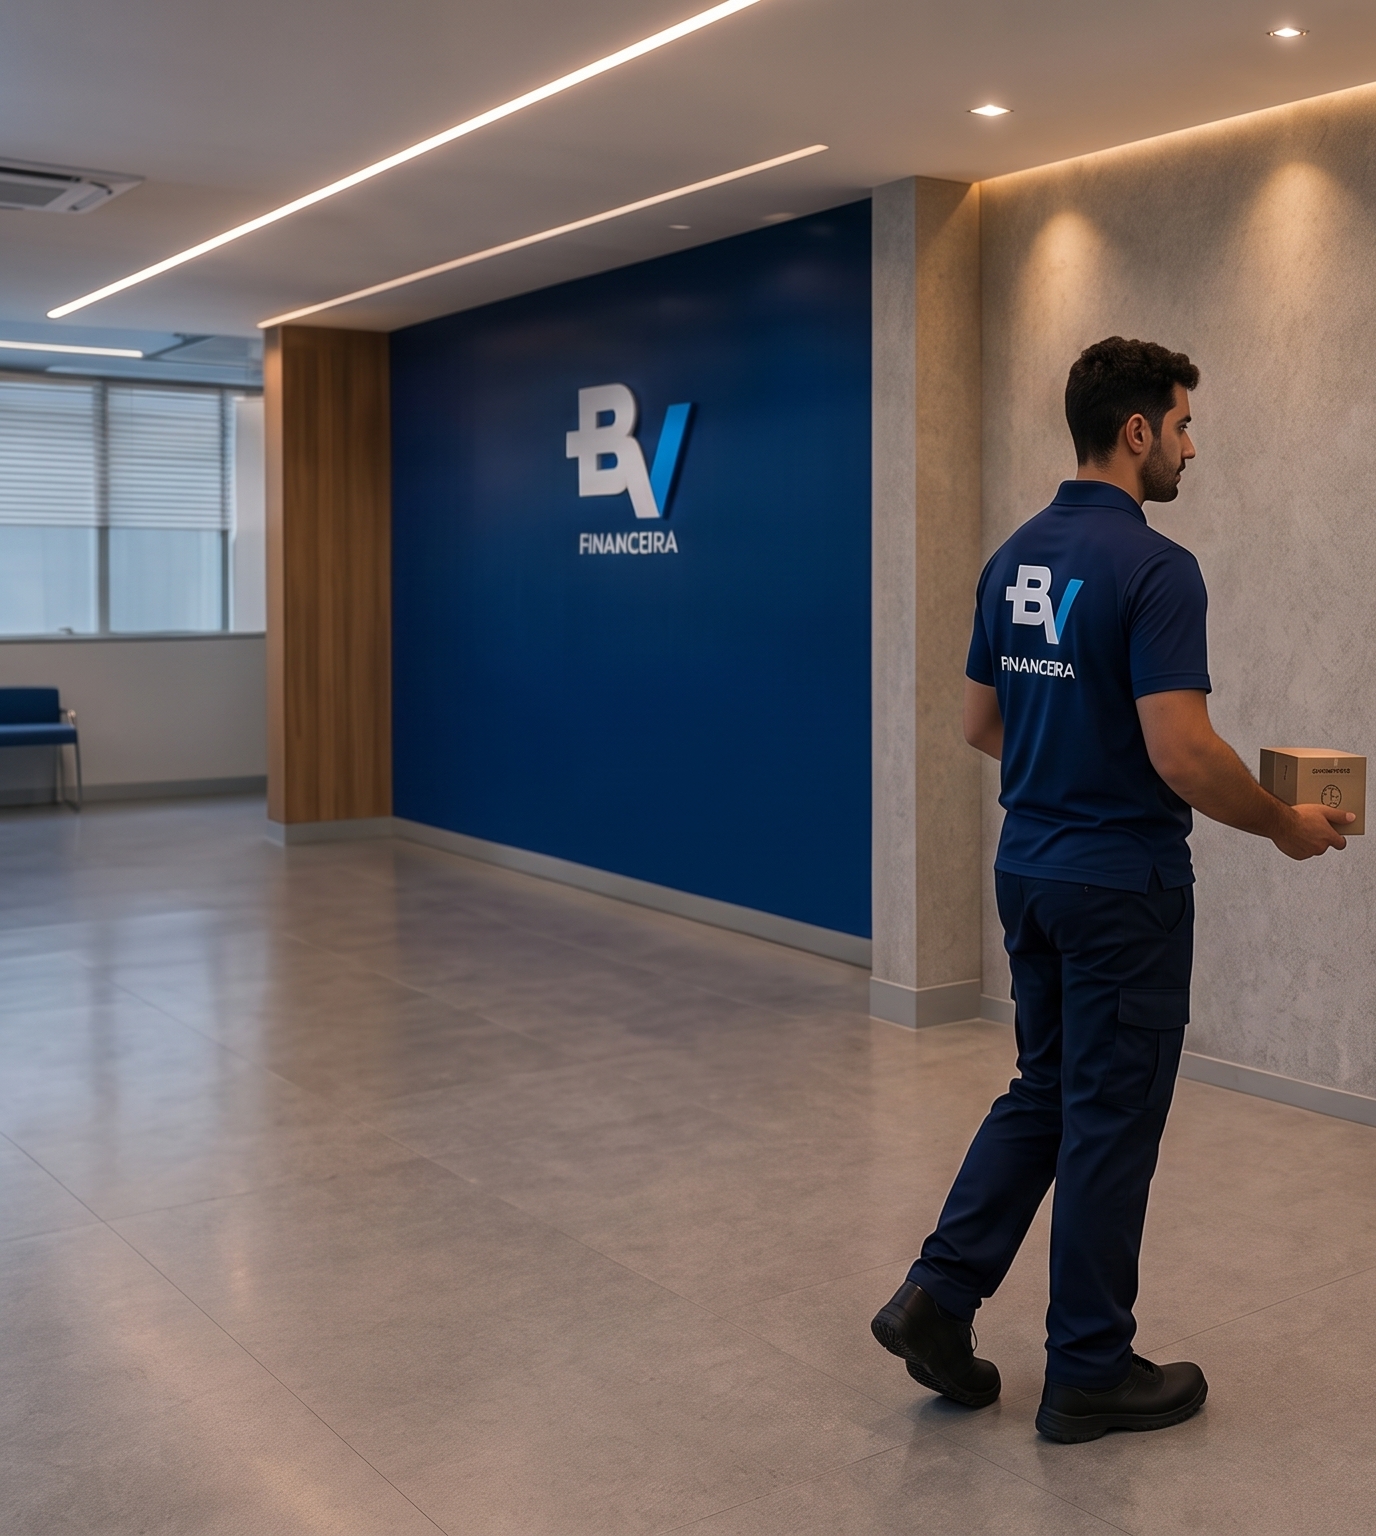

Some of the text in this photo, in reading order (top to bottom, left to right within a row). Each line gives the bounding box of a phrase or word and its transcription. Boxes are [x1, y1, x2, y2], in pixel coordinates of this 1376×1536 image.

[565, 382, 692, 519] BV
[579, 530, 679, 555] FINANCEIRA
[1005, 564, 1085, 645] BV
